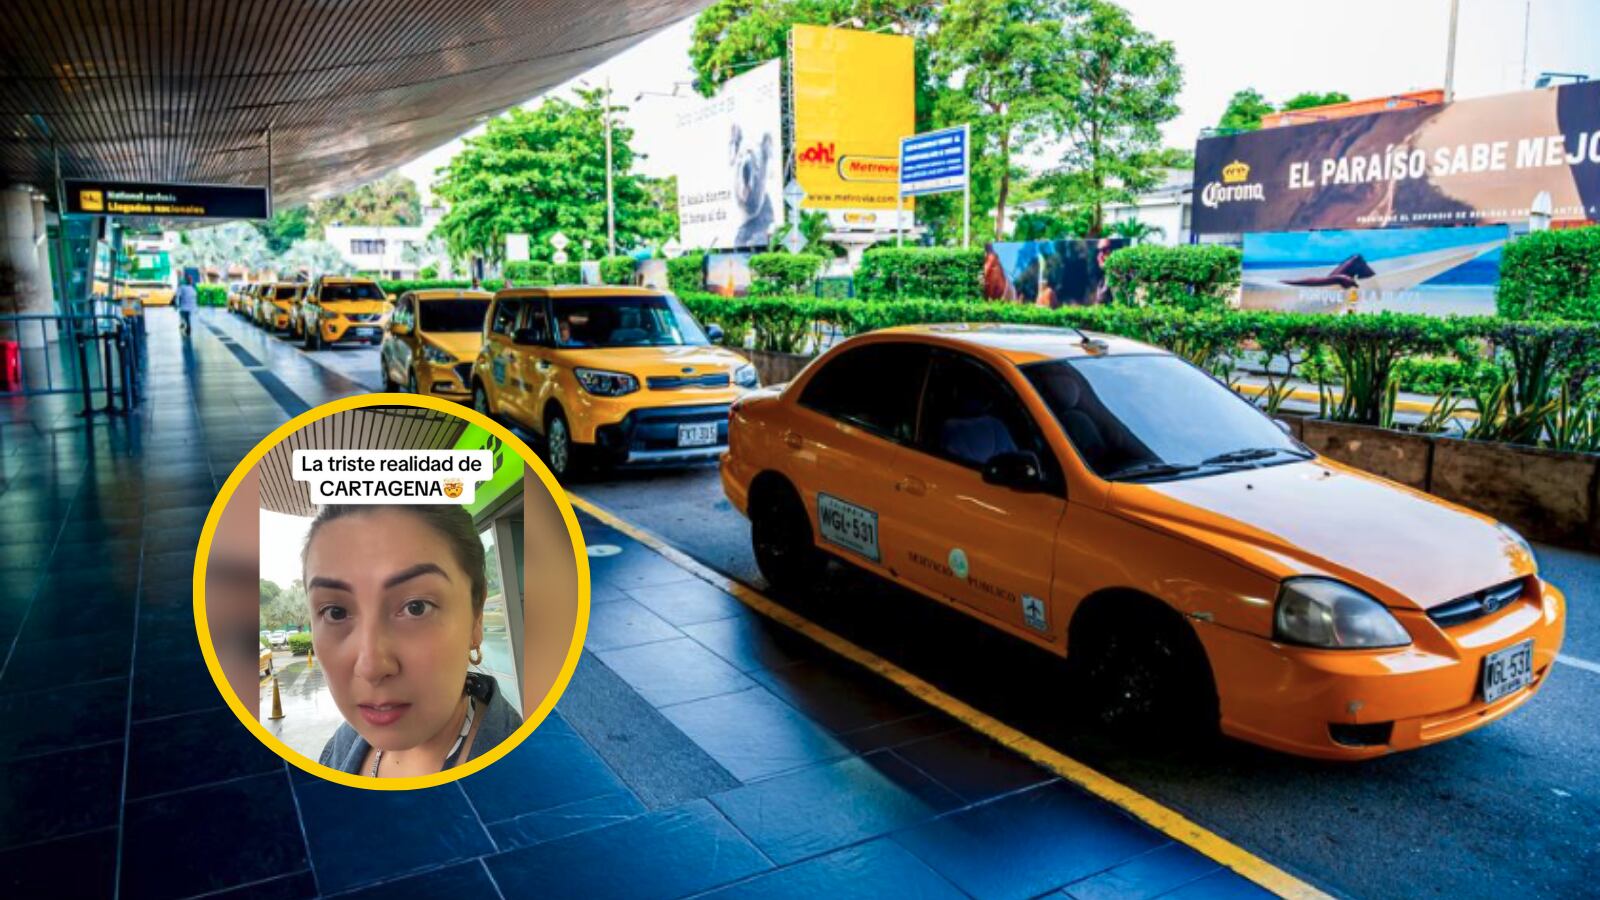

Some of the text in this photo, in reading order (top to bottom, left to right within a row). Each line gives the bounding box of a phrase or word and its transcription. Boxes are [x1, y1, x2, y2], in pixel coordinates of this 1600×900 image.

[1289, 161, 1315, 188] EL
[1322, 144, 1425, 187] PARAÍSO
[1433, 142, 1509, 176] SABE
[106, 190, 143, 200] National
[1202, 182, 1265, 209] Corona
[108, 202, 205, 214] Llegadas nacionales
